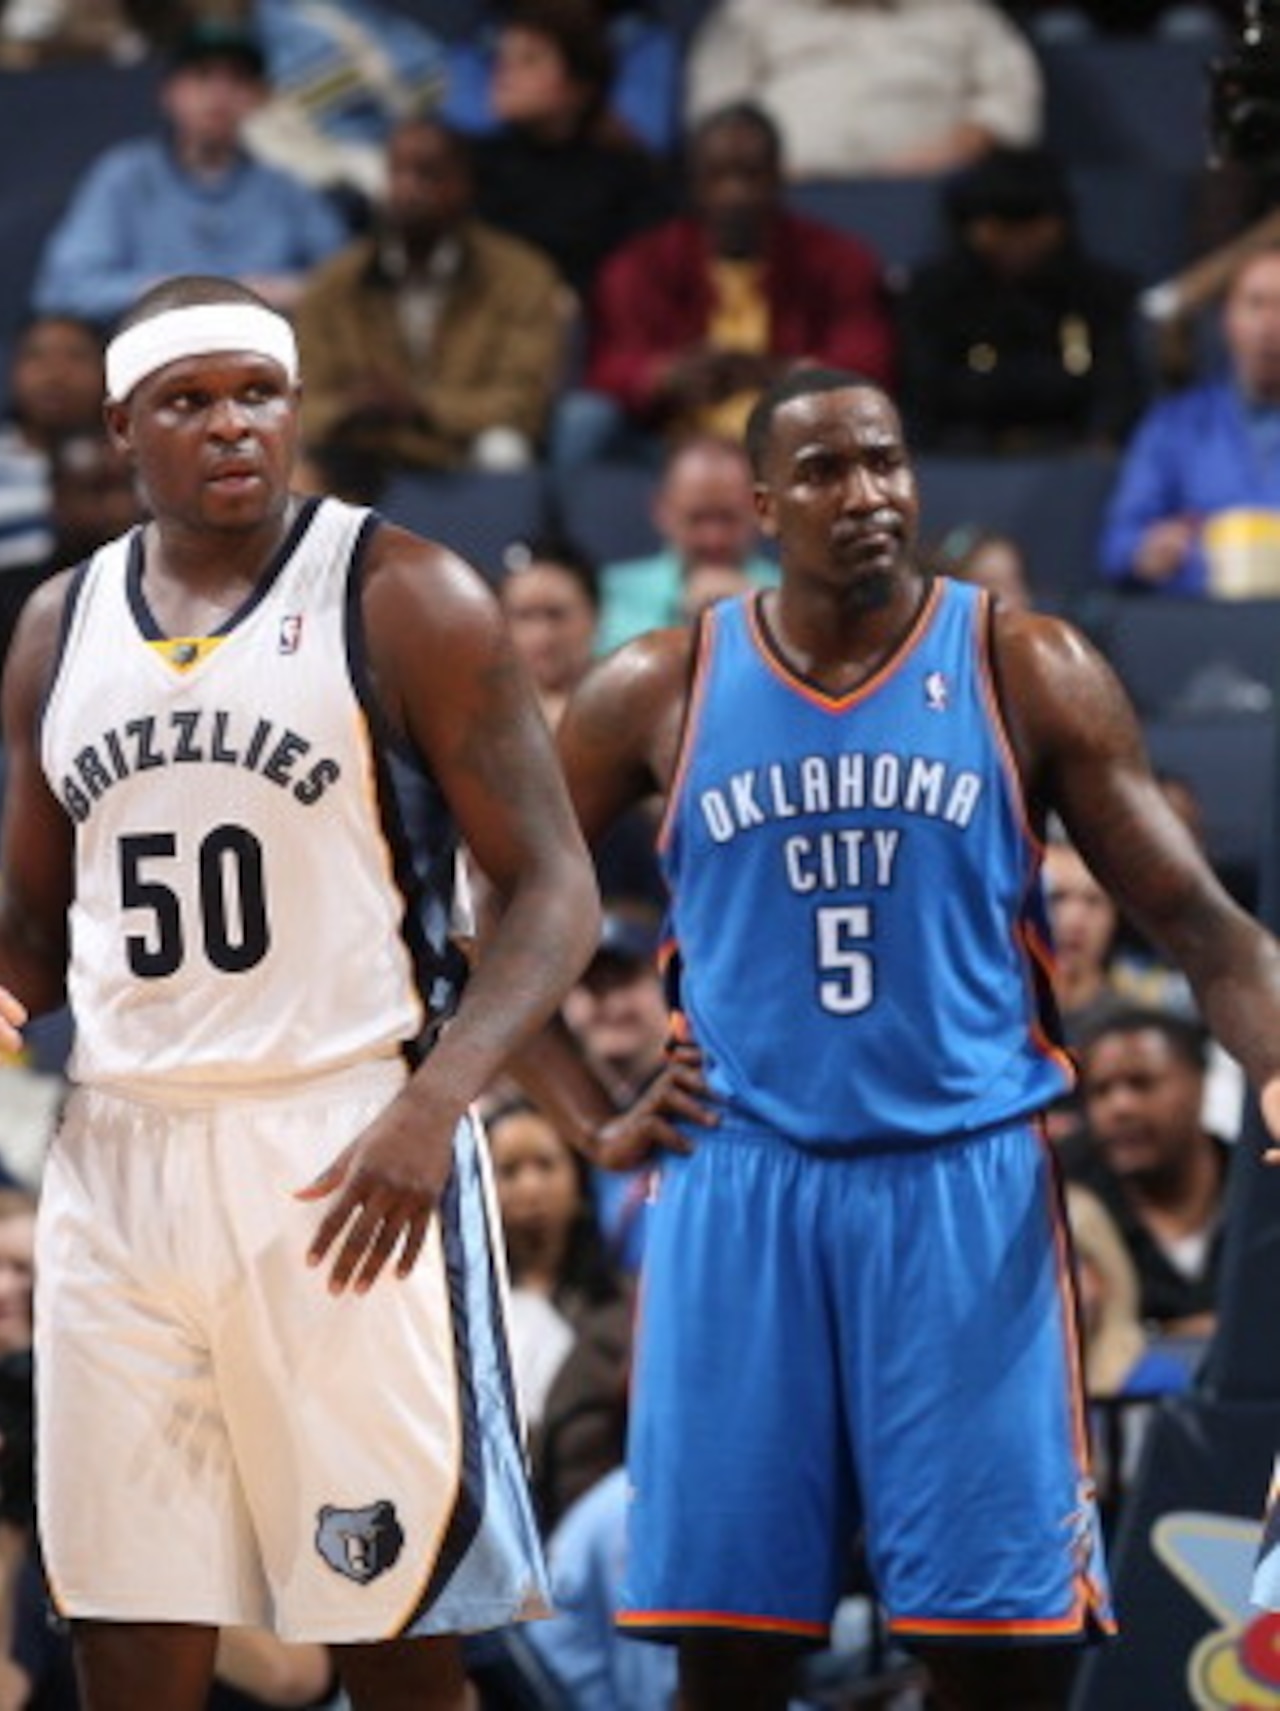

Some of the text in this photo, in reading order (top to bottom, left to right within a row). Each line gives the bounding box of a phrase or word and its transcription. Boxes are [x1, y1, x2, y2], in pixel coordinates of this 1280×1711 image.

[62, 710, 341, 824] GRIZZLIES
[699, 751, 983, 844] OKLAHOMA
[116, 823, 272, 980] 50
[783, 828, 901, 893] CITY
[814, 903, 876, 1016] 5
